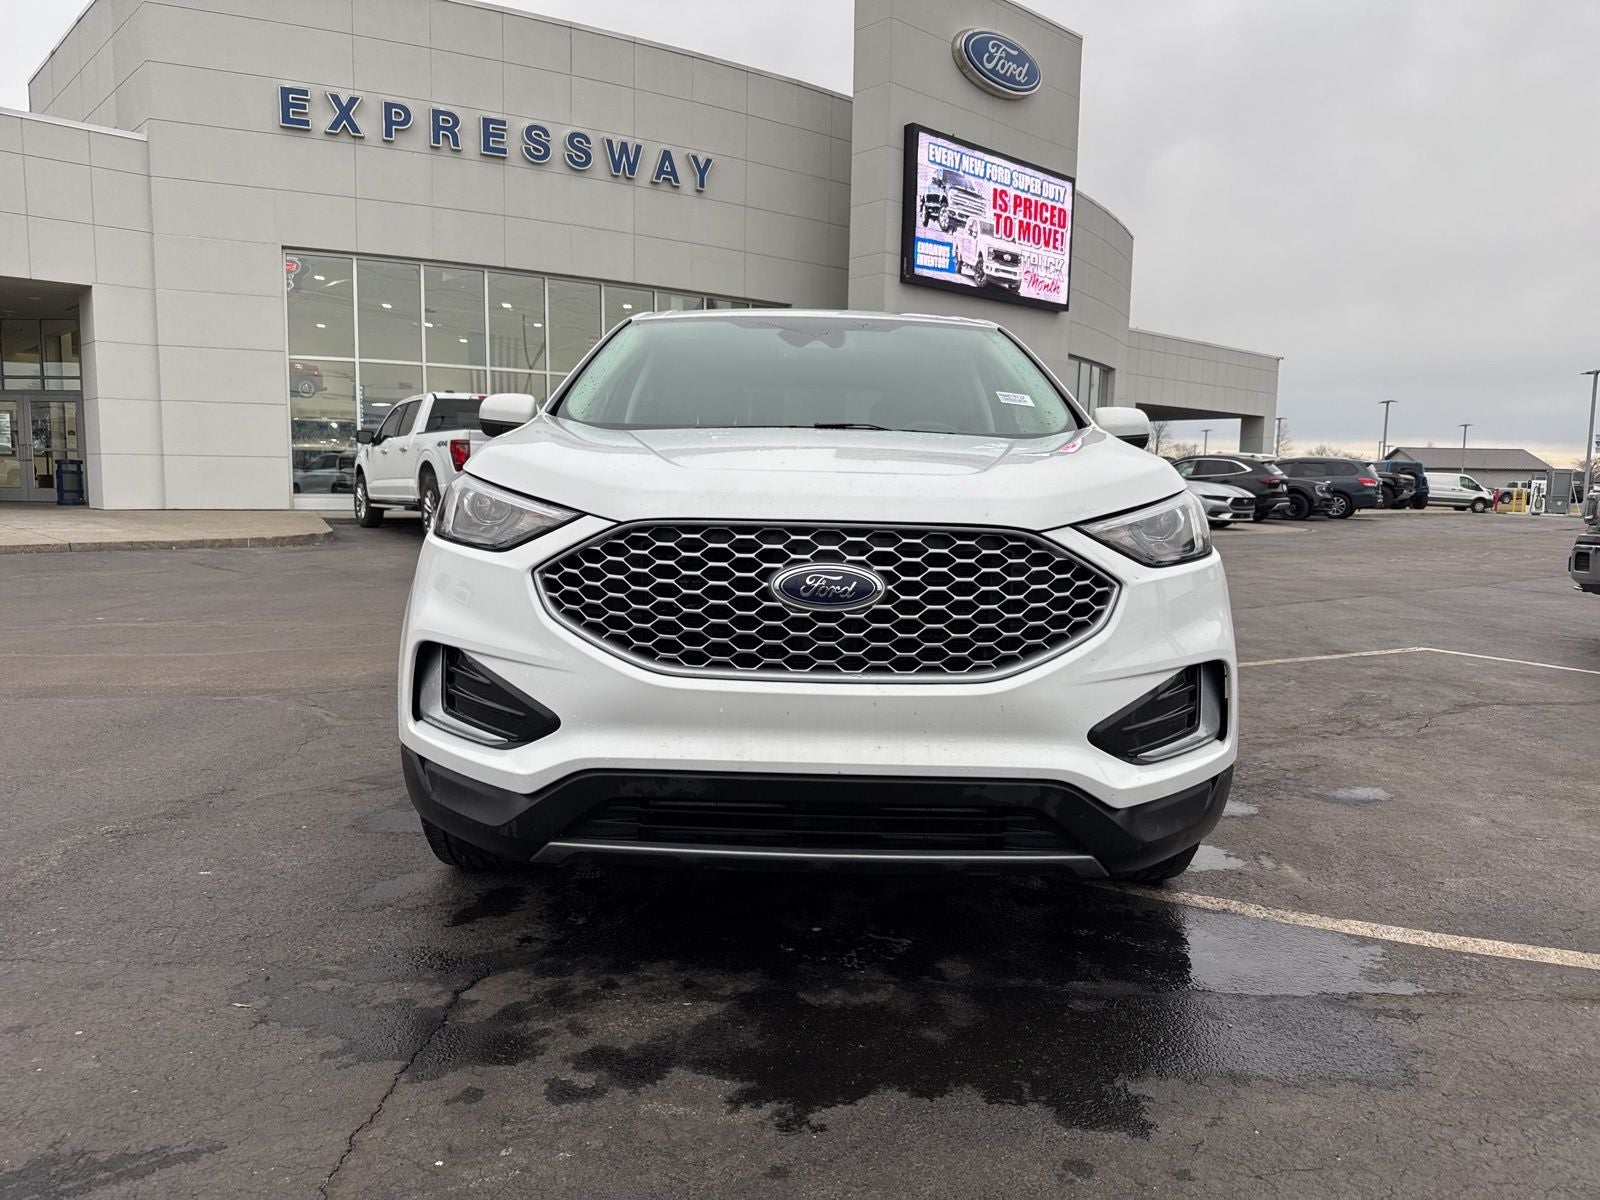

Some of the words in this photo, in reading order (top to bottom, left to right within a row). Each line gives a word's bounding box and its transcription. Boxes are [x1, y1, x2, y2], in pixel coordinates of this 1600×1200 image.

[983, 40, 1029, 83] Ford
[278, 84, 715, 191] EXPRESSWAY
[928, 143, 961, 171] EVERY
[961, 153, 986, 178] NEW
[986, 162, 1012, 186] FORD
[1012, 170, 1042, 196] SUPER
[1042, 180, 1067, 203] DUTY
[992, 187, 1009, 213] IS
[1012, 194, 1068, 229] PRICED
[993, 213, 1014, 239] TO
[1017, 220, 1066, 252] MOVE!
[800, 574, 857, 598] Ford
